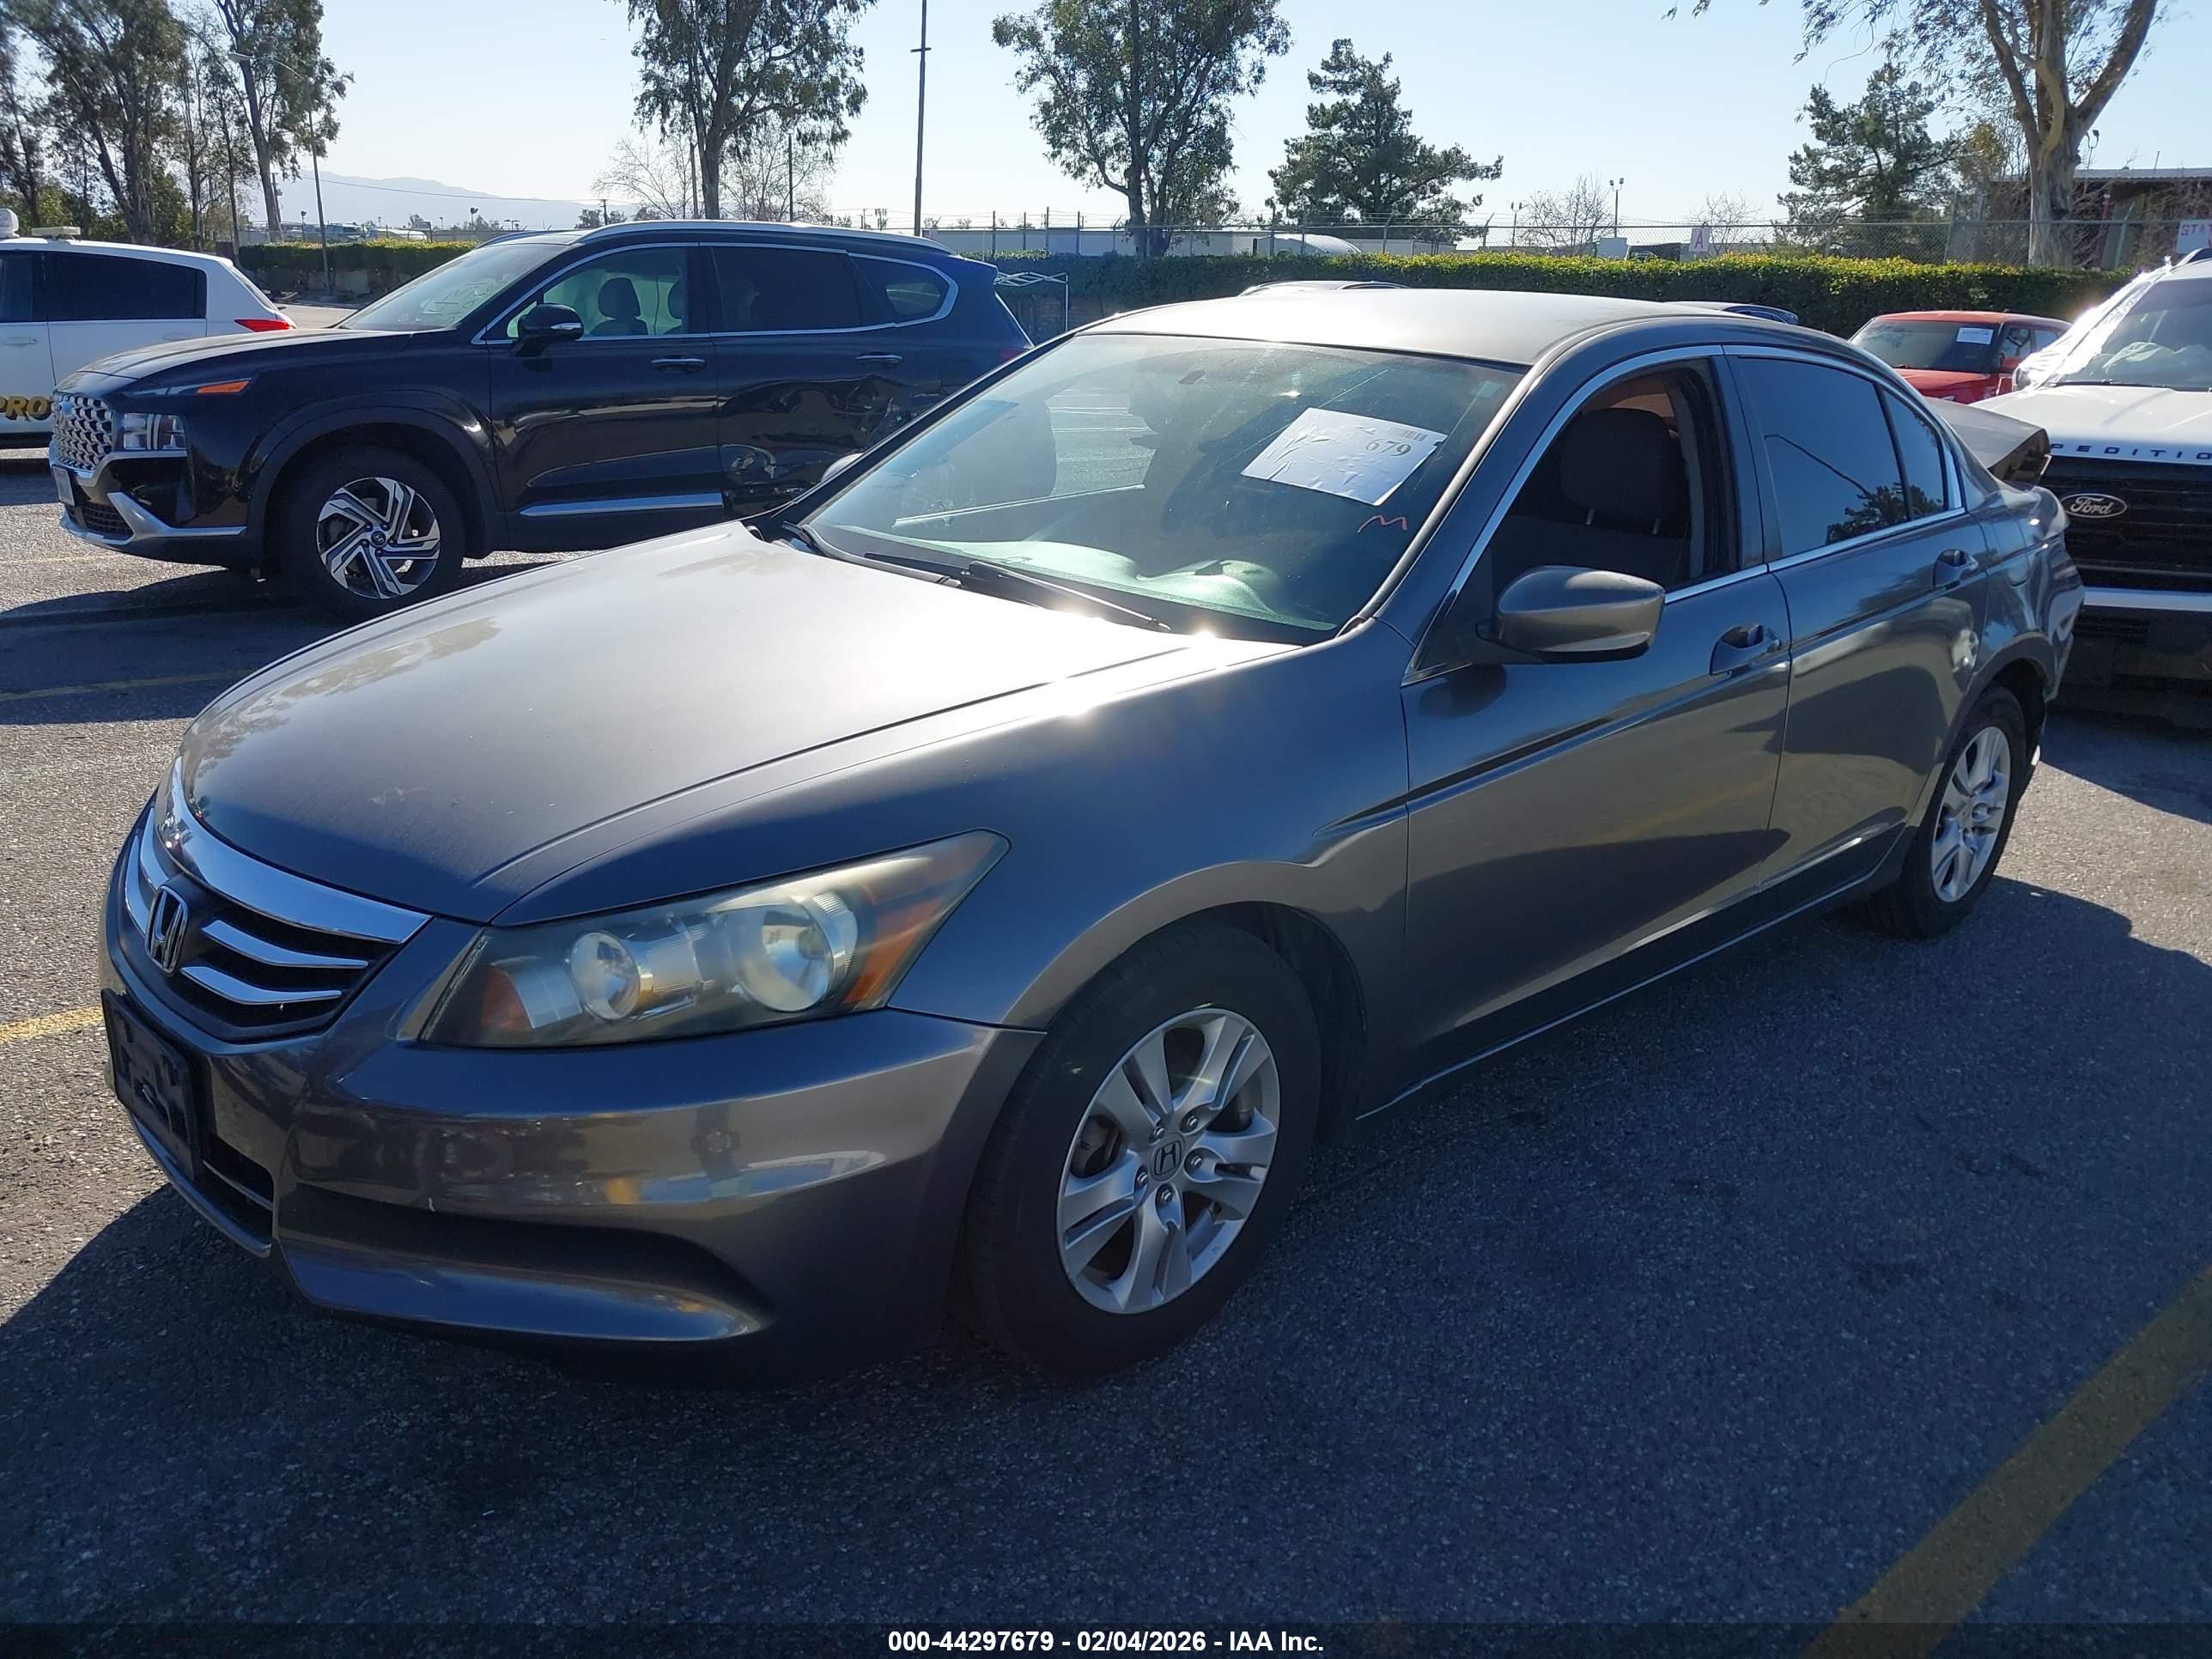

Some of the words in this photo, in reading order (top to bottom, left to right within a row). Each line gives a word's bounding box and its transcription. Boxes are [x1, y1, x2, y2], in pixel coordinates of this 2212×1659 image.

[1694, 229, 1704, 249] A
[1365, 438, 1413, 457] 679
[2051, 443, 2212, 460] PEDITIO
[2070, 495, 2114, 514] Ford
